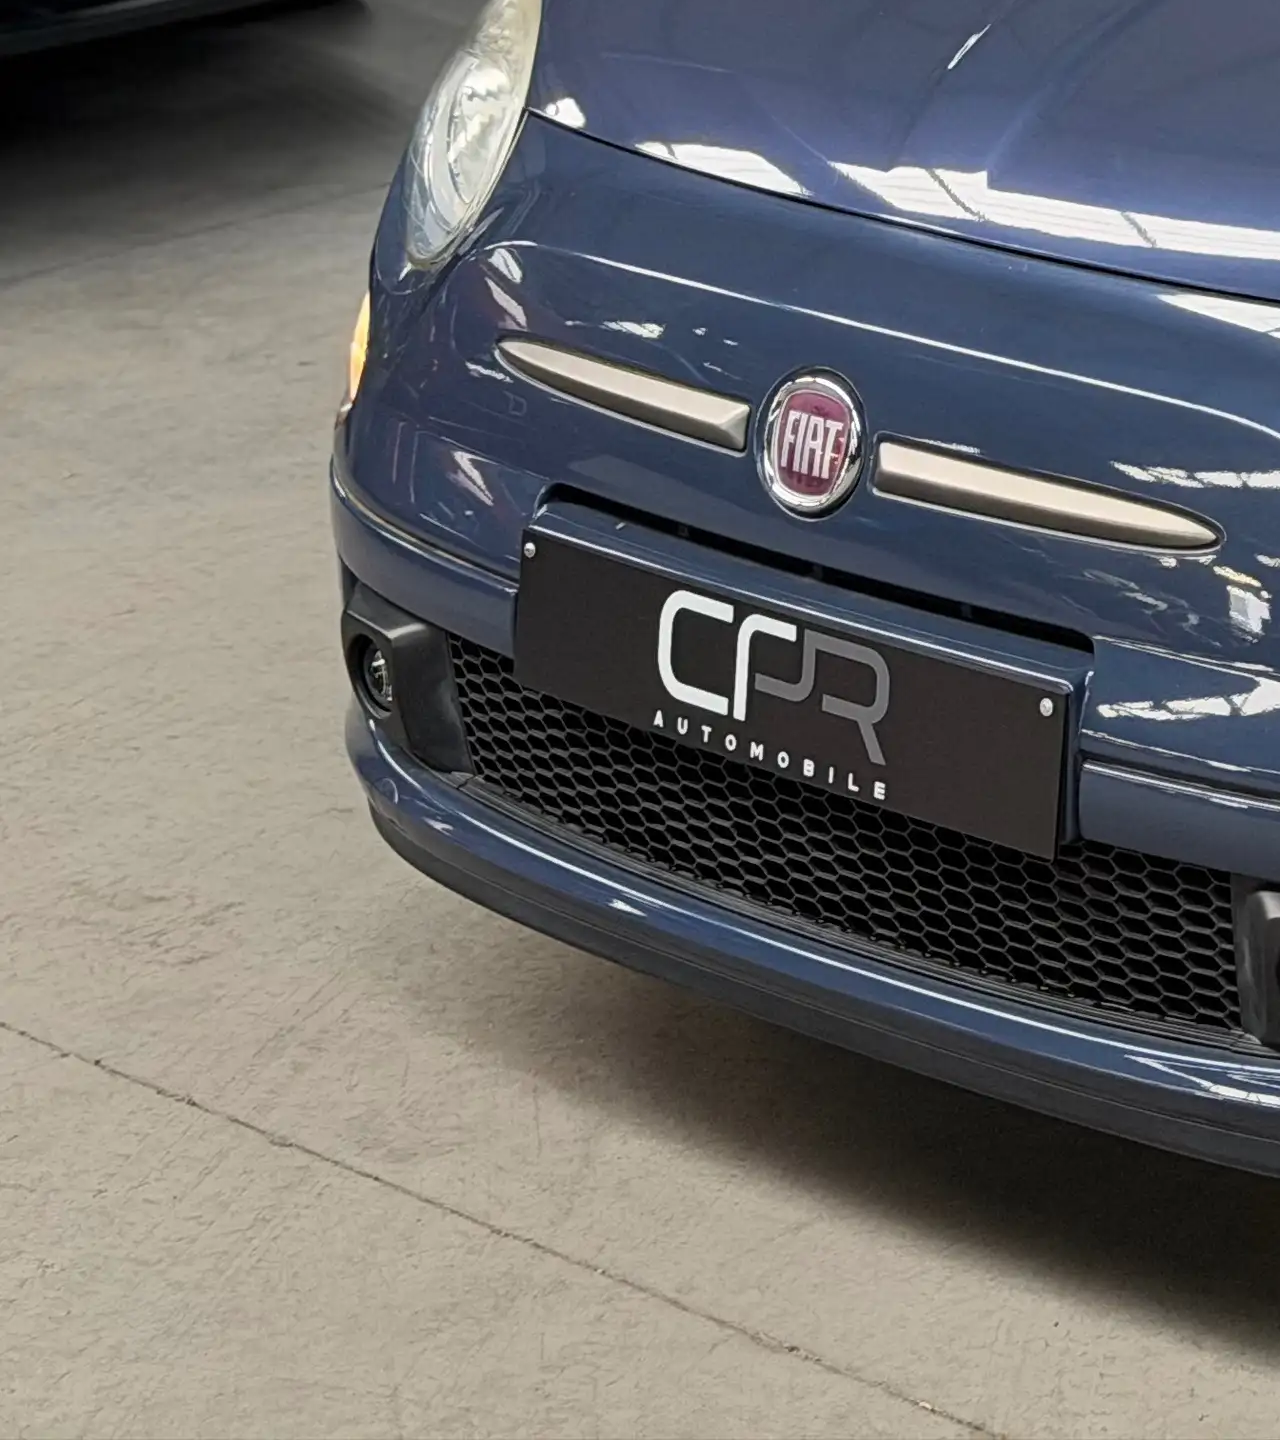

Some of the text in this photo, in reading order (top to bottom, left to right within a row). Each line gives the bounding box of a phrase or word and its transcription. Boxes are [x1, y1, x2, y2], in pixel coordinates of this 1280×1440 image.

[780, 410, 844, 479] FIAT
[657, 589, 890, 766] CPR
[653, 710, 887, 800] AUTOMOBILE
